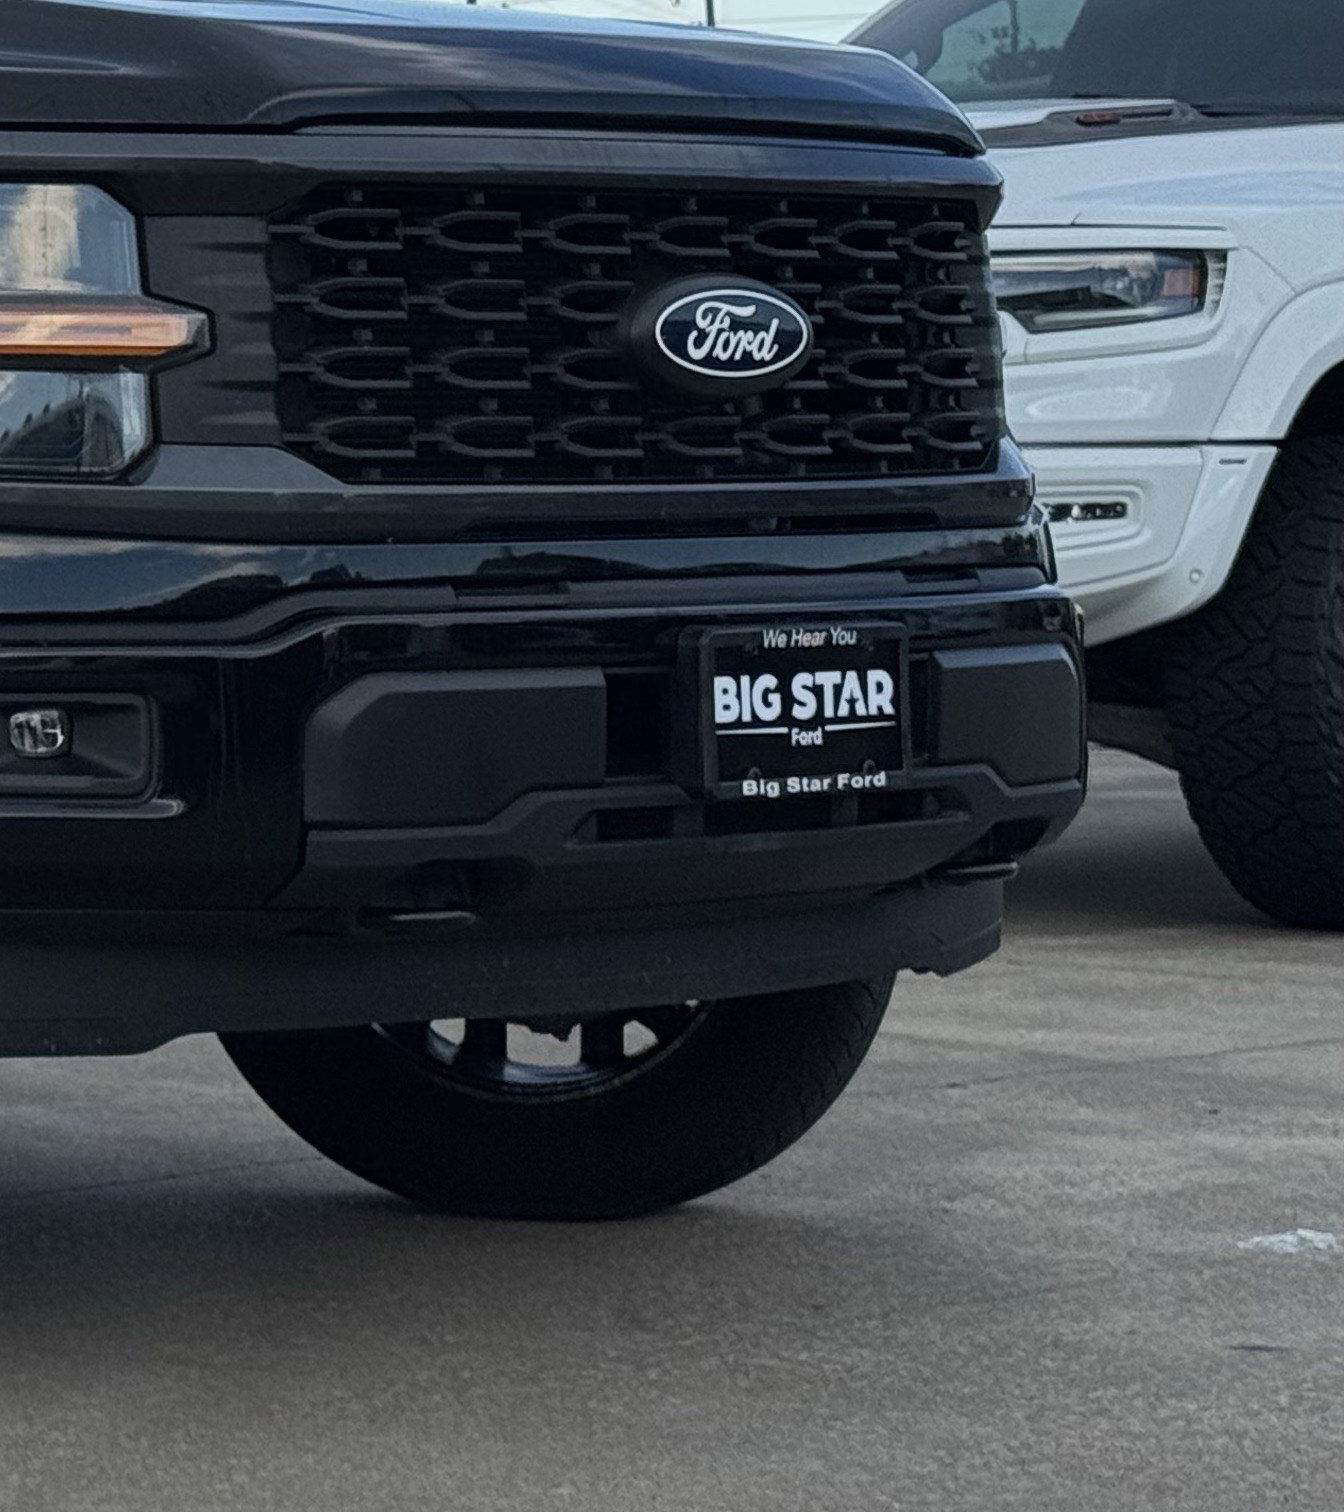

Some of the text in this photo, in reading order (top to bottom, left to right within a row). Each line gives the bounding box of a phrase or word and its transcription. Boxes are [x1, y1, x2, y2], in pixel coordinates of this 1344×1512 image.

[687, 301, 779, 361] Ford
[763, 626, 858, 648] We Hear You
[714, 669, 896, 723] BIG STAR
[791, 727, 823, 746] Ford
[742, 771, 886, 798] Big Star Ford
